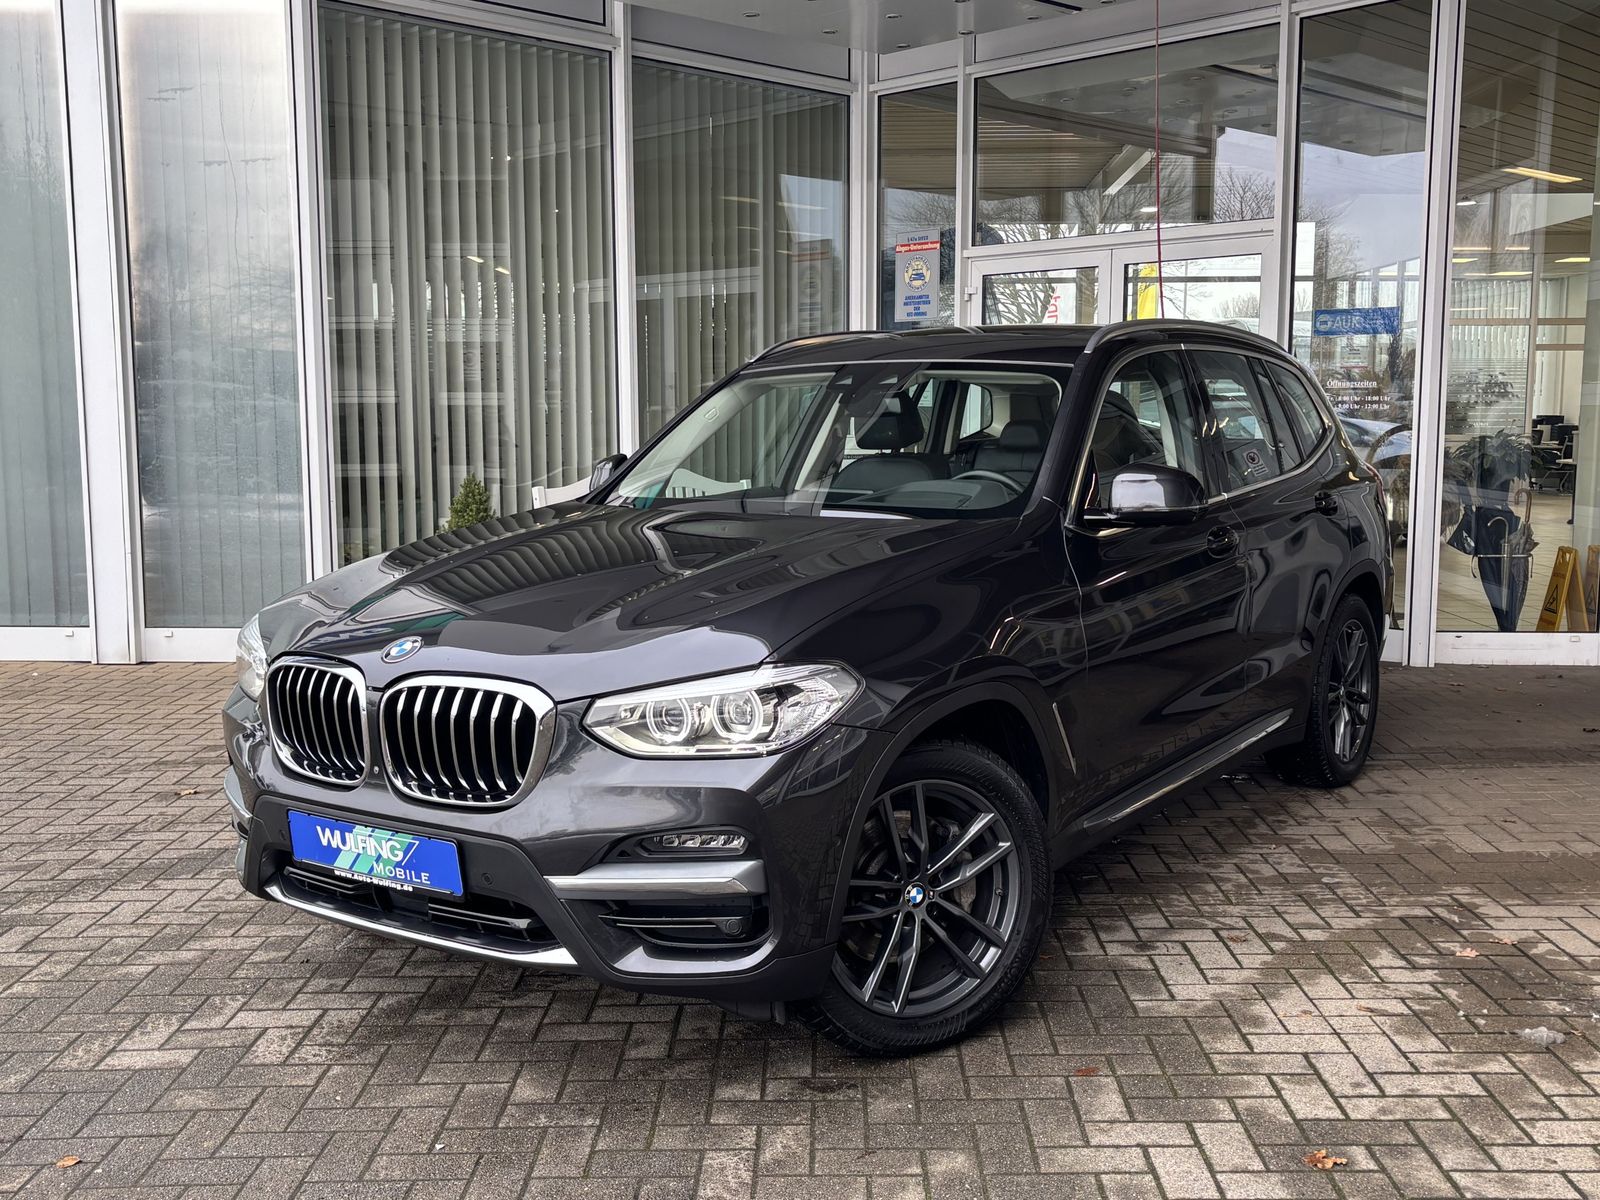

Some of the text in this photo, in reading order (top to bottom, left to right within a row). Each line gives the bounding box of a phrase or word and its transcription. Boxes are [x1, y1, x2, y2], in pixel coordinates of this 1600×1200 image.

[1326, 378, 1377, 388] Öffnungszeiten
[316, 825, 404, 862] WULFING
[373, 861, 431, 884] MOBILE
